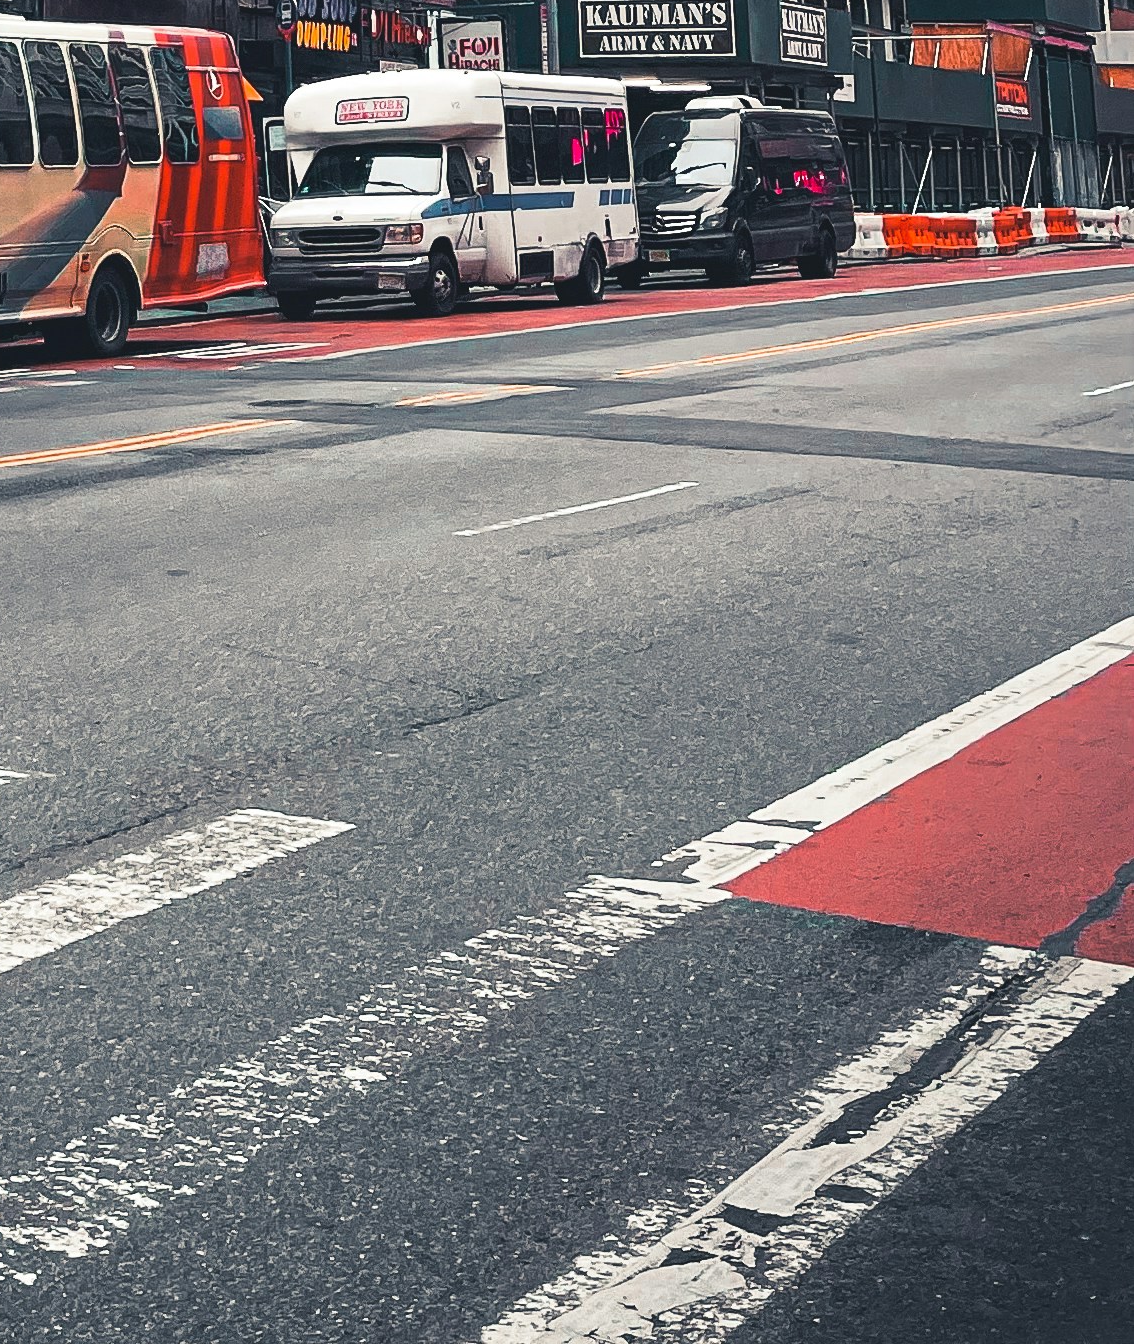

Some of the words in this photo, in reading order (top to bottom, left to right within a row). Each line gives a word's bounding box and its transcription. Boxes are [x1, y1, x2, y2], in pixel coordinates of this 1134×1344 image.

[585, 1, 728, 27] KAUFMAN'S
[296, 20, 351, 52] DUMPLING
[599, 34, 648, 52] ARMY
[651, 34, 665, 52] &
[669, 34, 715, 52] NAVY
[372, 99, 404, 111] YORK
